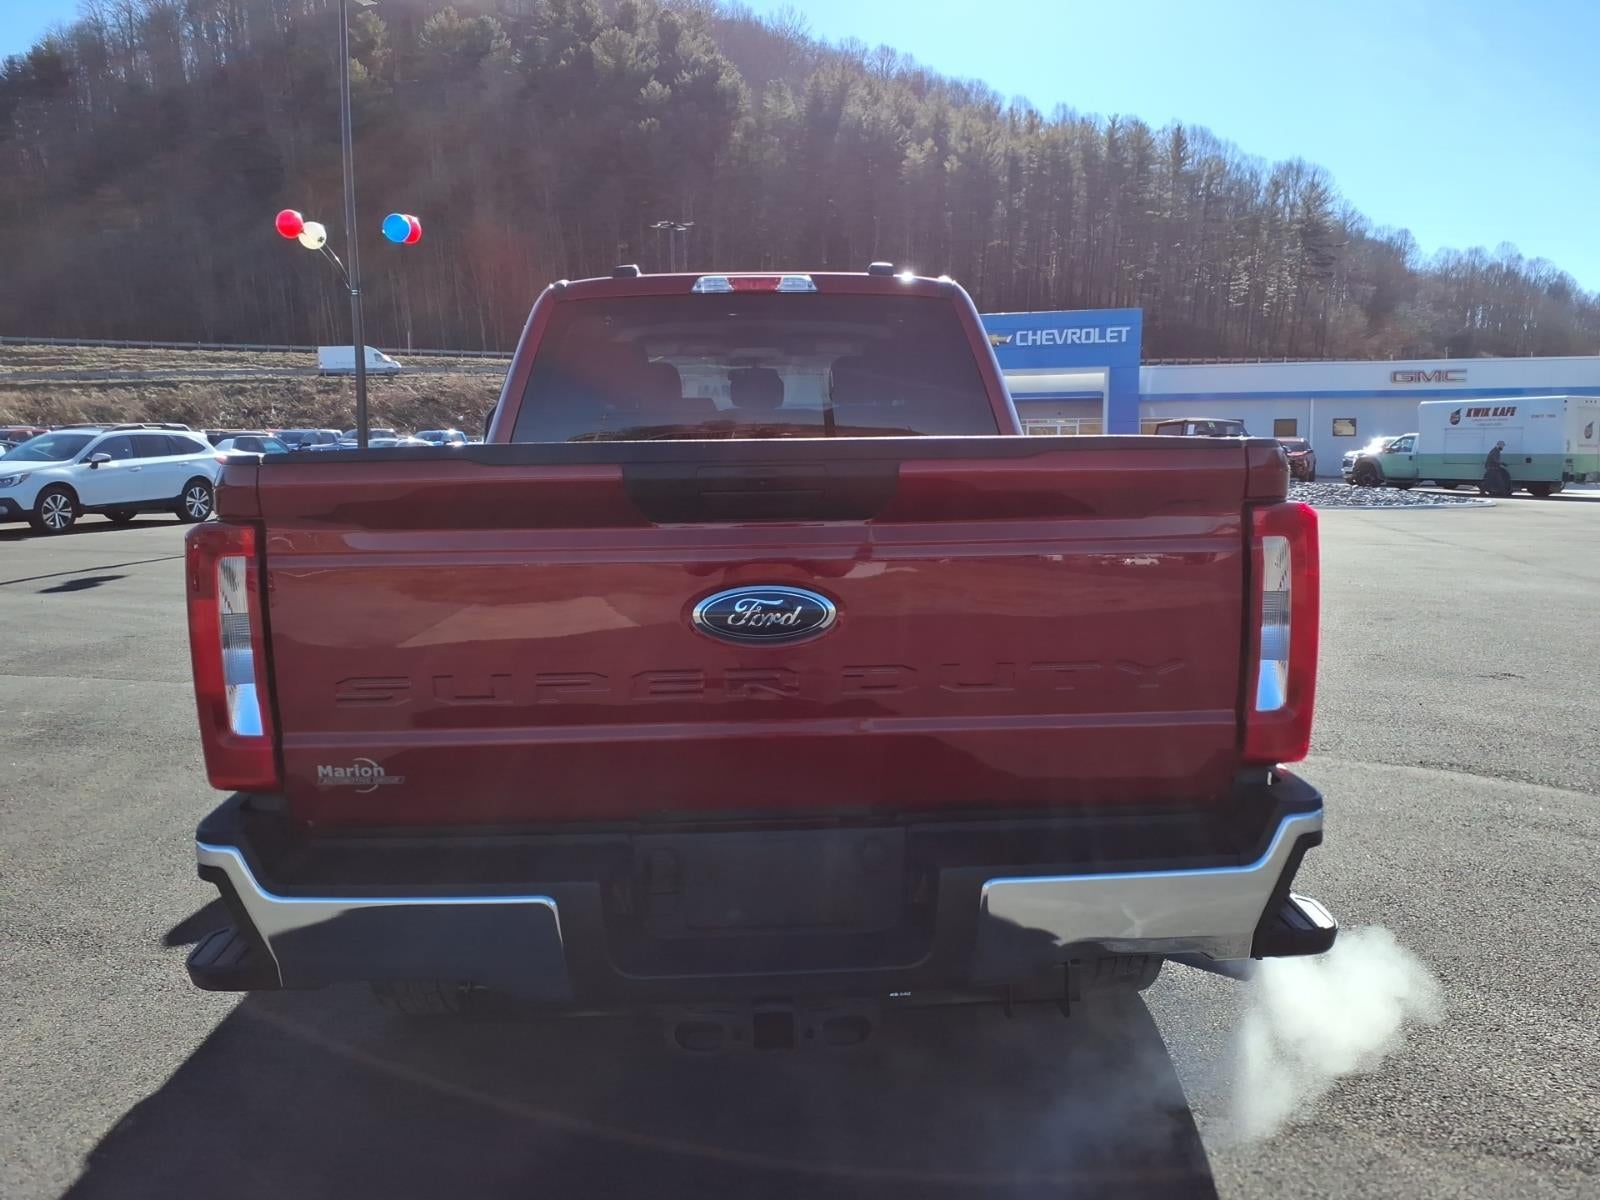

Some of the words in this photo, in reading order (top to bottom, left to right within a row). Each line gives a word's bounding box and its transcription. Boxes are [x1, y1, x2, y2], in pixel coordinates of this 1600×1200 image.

[1015, 326, 1131, 346] CHEVROLET
[1391, 369, 1467, 383] GMC
[1465, 407, 1491, 418] KWIK
[1492, 406, 1517, 417] KAFE
[727, 598, 803, 627] Ford
[335, 667, 800, 707] SUPER
[841, 658, 1186, 695] DUTY
[317, 764, 385, 777] Marion
